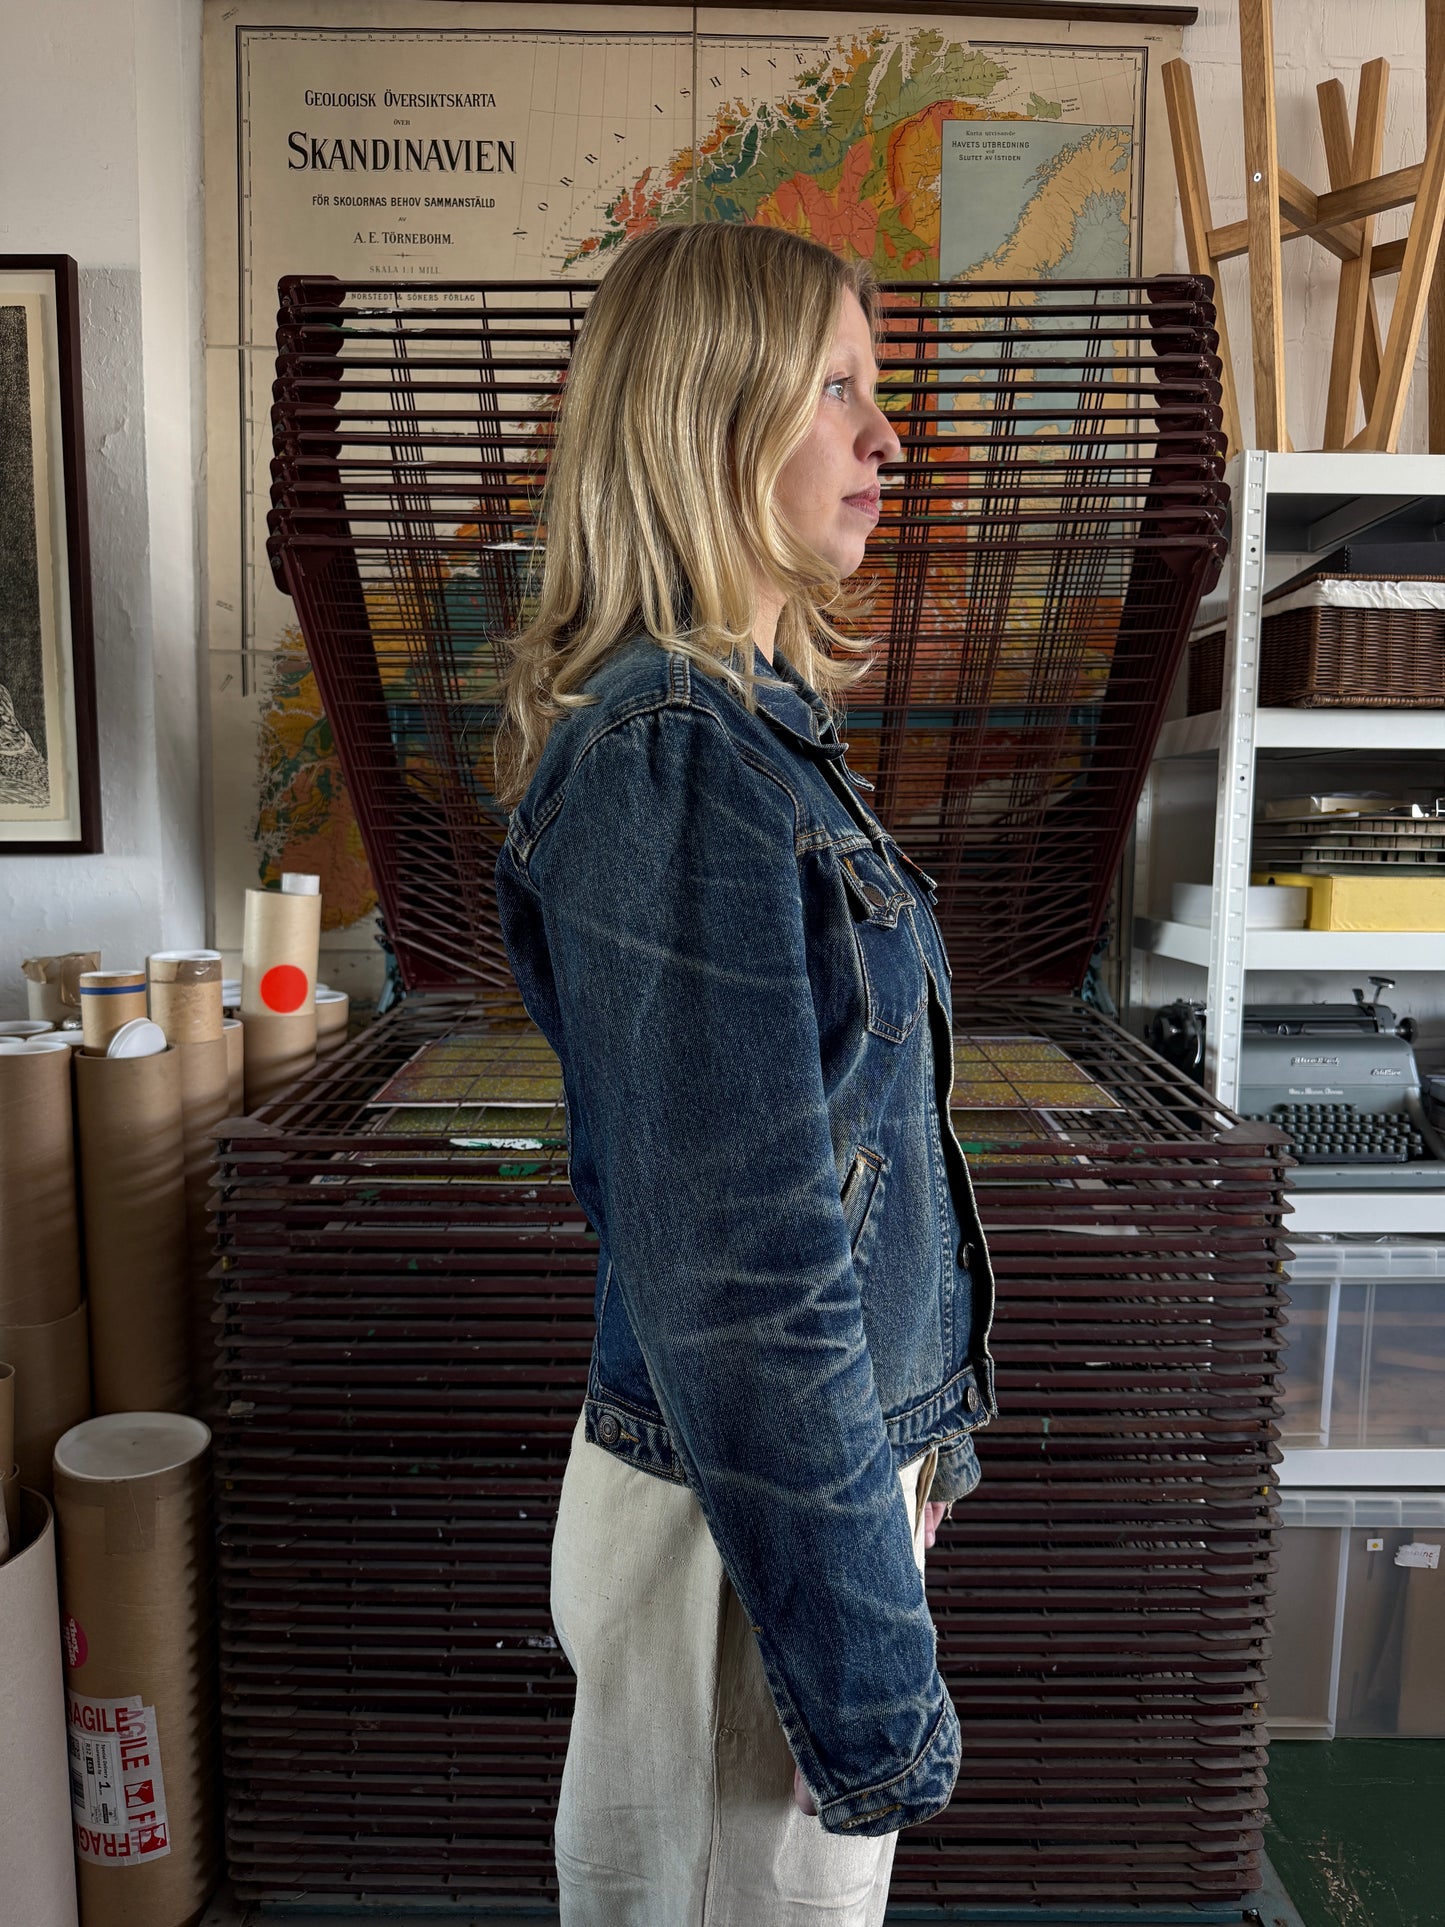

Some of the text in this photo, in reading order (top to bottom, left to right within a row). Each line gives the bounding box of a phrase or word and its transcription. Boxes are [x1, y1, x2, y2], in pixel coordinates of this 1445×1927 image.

[304, 88, 497, 109] GEOLOGISK ÖVERSIKTSKARTA
[952, 140, 1030, 149] HAVETS UTBREDNING
[287, 131, 518, 174] SKANDINAVIEN
[312, 195, 496, 209] FÖR SKOLORNAS BEHOV SAMMANSTÄLLD
[381, 231, 455, 245] TÖRNEBOHM.
[369, 265, 399, 274] SKALA
[351, 292, 394, 301] NORSTEDT
[407, 293, 440, 302] SÖNERS
[443, 293, 476, 302] FÖRLAG
